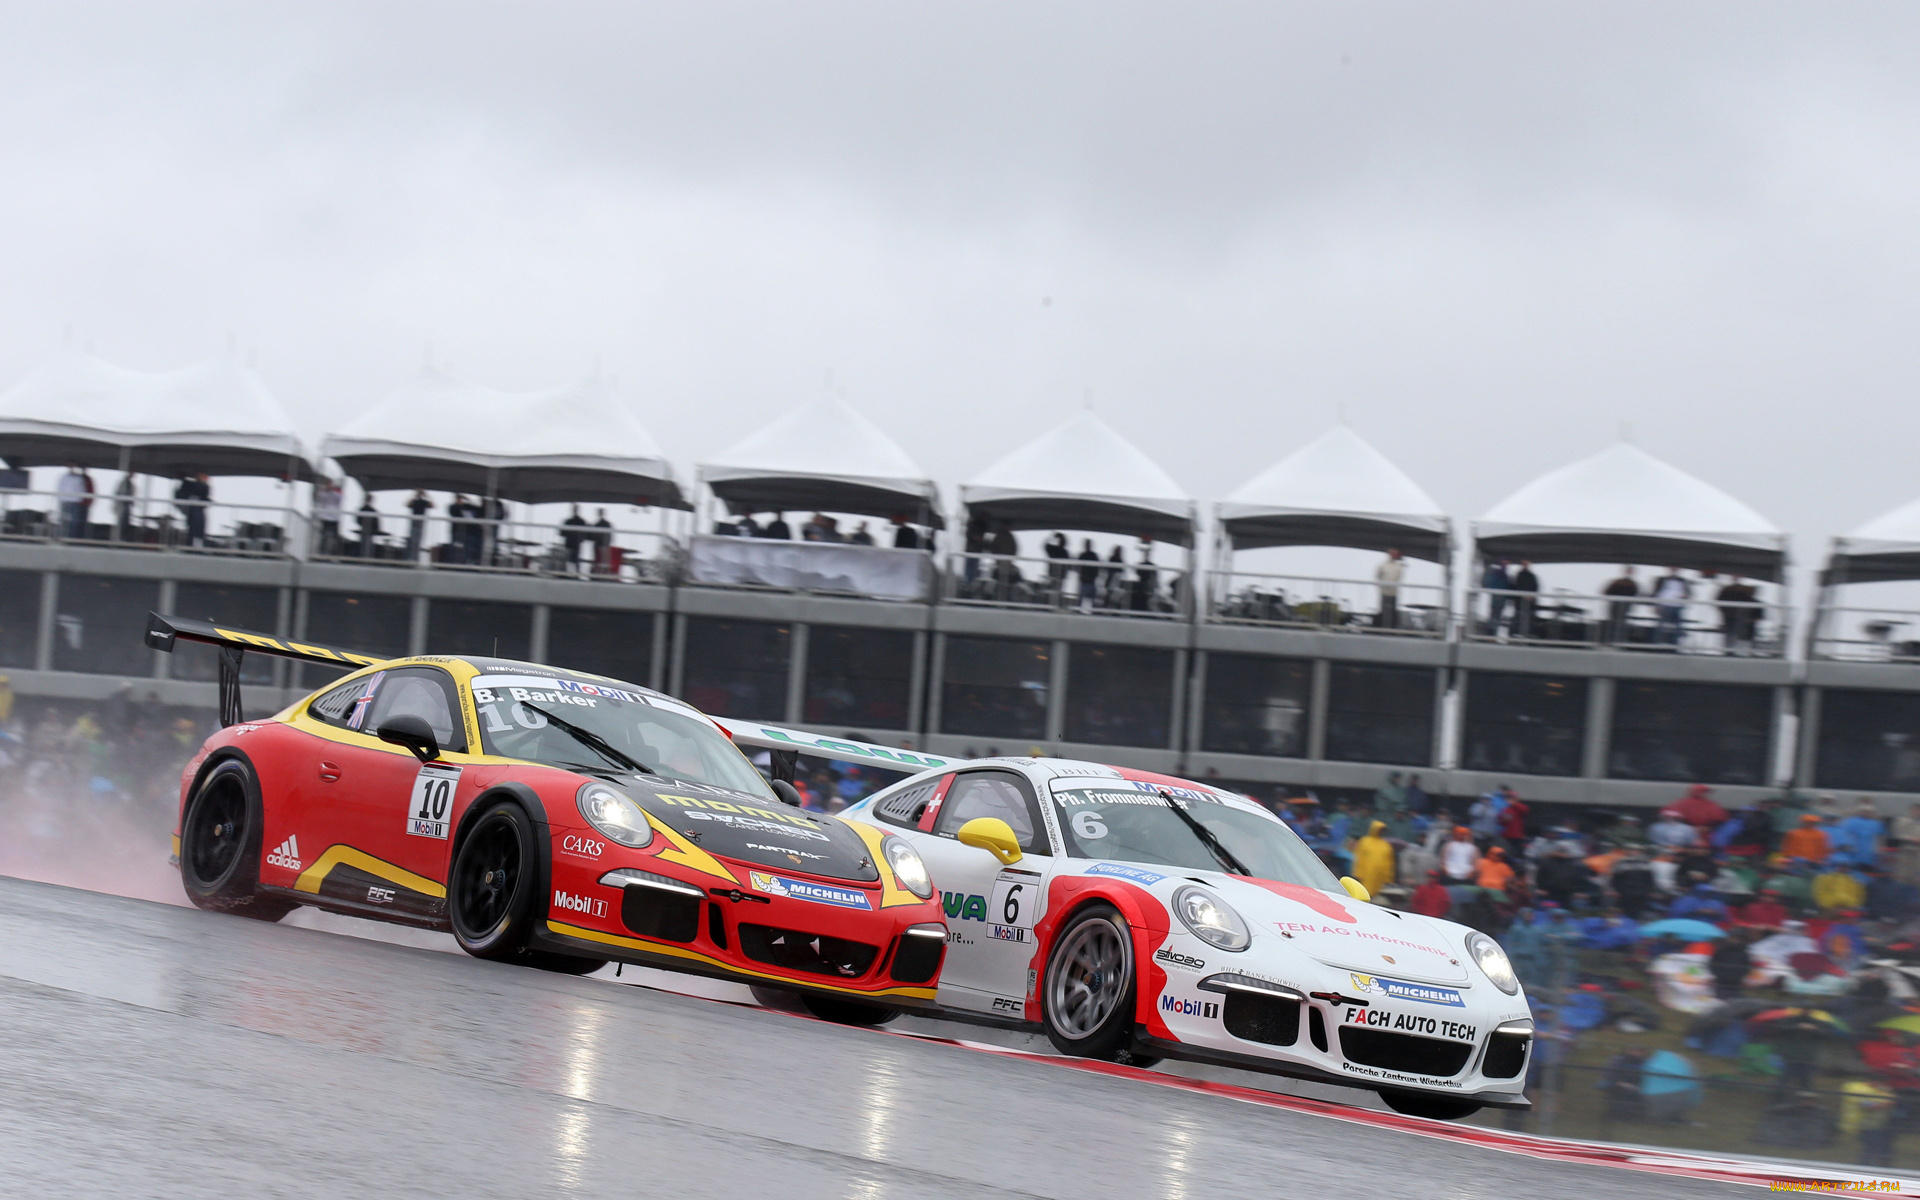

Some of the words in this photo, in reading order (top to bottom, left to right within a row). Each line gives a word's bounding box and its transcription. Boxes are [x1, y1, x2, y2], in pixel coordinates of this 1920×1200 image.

[504, 666, 556, 677] Megatron
[473, 688, 505, 704] B.
[509, 687, 598, 708] Barker
[557, 680, 628, 702] Mobil
[478, 702, 548, 733] 10
[419, 780, 450, 820] 10
[1053, 793, 1087, 808] Ph.
[1132, 782, 1201, 801] Mobil
[655, 793, 822, 831] momo
[414, 821, 434, 835] Mobil
[1072, 811, 1108, 840] 6
[563, 835, 606, 856] CARS
[745, 842, 828, 860] PARTRAX
[266, 853, 302, 870] adidas
[368, 886, 396, 900] PFC
[554, 890, 592, 914] Mobil
[790, 883, 866, 905] MICHELIN
[1004, 884, 1024, 924] 6
[994, 926, 1016, 940] Mobil
[1273, 922, 1315, 932] TEN
[1321, 926, 1351, 937] AG
[1356, 930, 1450, 959] Informatik
[1246, 971, 1267, 980] BANK
[1268, 976, 1301, 989] SCHWEIZ
[1388, 984, 1460, 1003] MICHELIN
[992, 998, 1023, 1012] PFC
[1162, 995, 1202, 1016] Mobil
[1345, 1007, 1392, 1028] FACH
[1394, 1013, 1437, 1035] AUTO
[1441, 1020, 1476, 1042] TECH
[1342, 1062, 1379, 1077] Porsche
[1381, 1070, 1418, 1083] Zentrum
[1419, 1076, 1463, 1089] Winterthur
